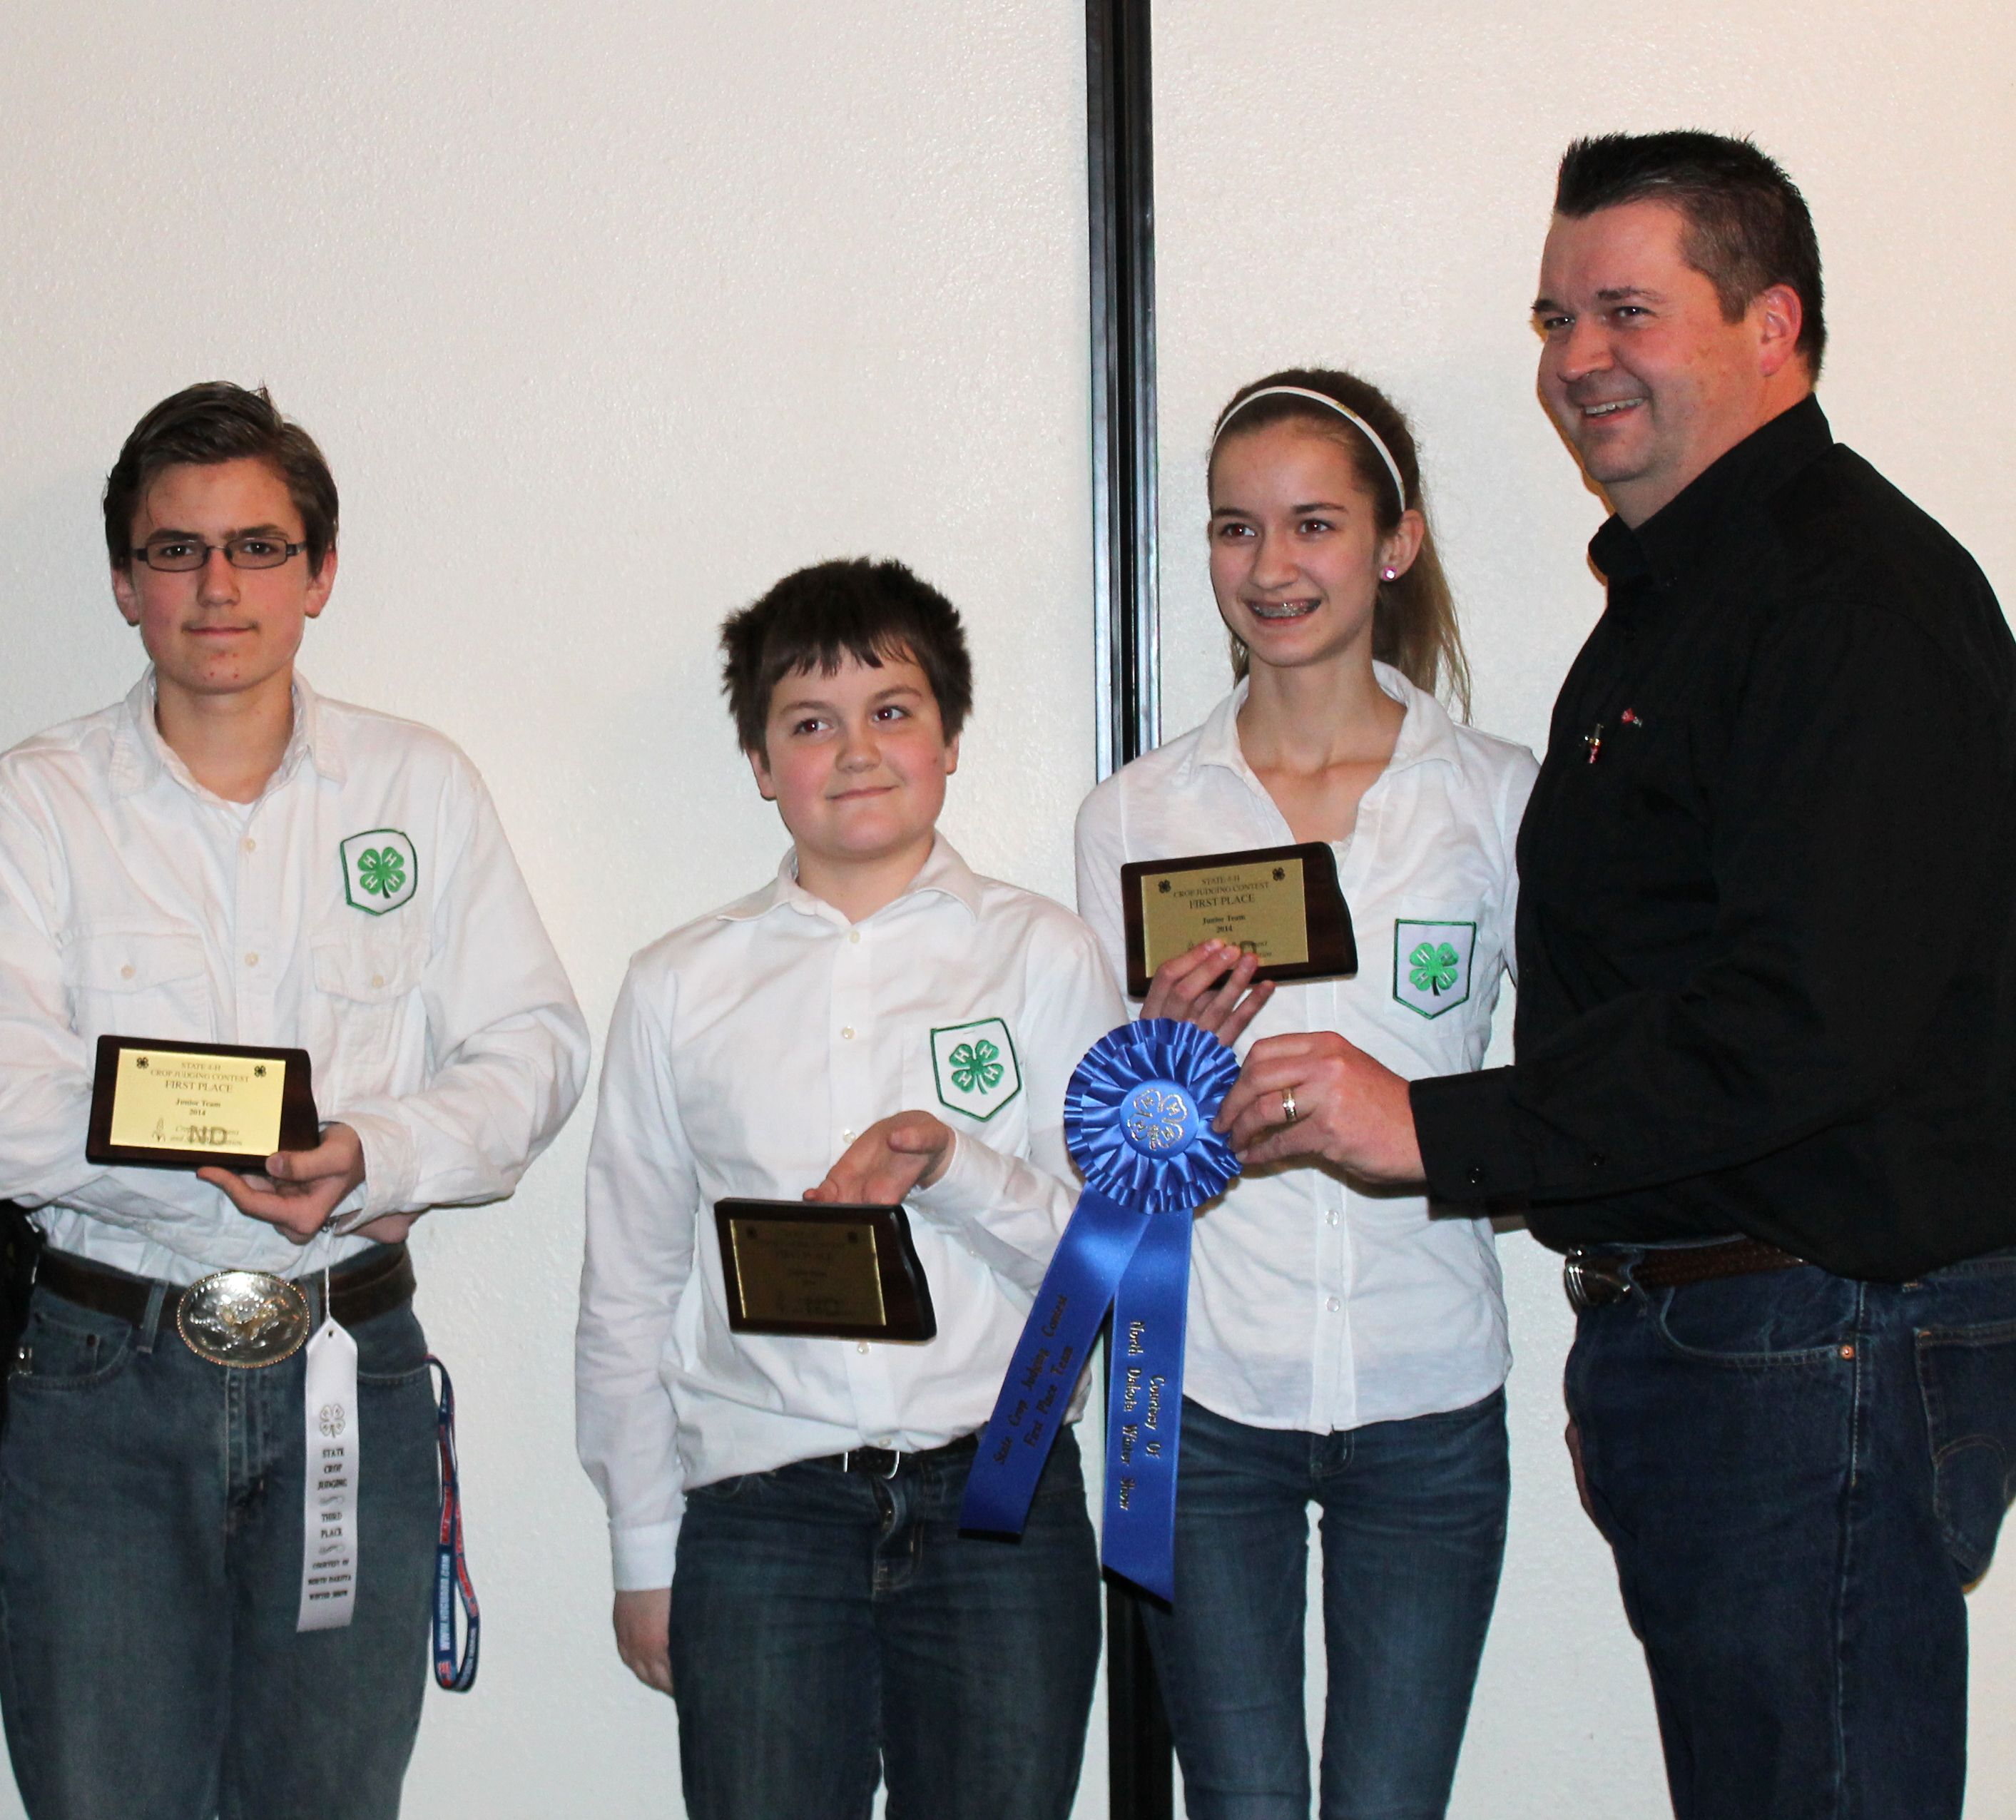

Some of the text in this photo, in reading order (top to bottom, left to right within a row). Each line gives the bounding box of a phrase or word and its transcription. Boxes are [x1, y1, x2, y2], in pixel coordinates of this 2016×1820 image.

[1233, 882, 1269, 892] CONTEST
[1189, 894, 1256, 909] FIRST PLACE
[1202, 917, 1224, 925] Junior
[1216, 925, 1233, 933] 2014
[212, 1074, 249, 1082] CONTEST
[165, 1080, 233, 1093] FIRST PLACE
[175, 1098, 199, 1107] Junior
[188, 1125, 227, 1145] ND
[993, 1293, 1068, 1465] State Crop Judging Contest
[1024, 1346, 1074, 1448] First Place Team
[1120, 1321, 1145, 1510] North Dakota Winter Show
[1145, 1375, 1166, 1458] Courtesy Of
[322, 1447, 345, 1458] STATE
[324, 1463, 342, 1473] CROP
[317, 1478, 347, 1490] JUDGING
[321, 1512, 342, 1522] THIRD
[321, 1527, 342, 1539] PLACE
